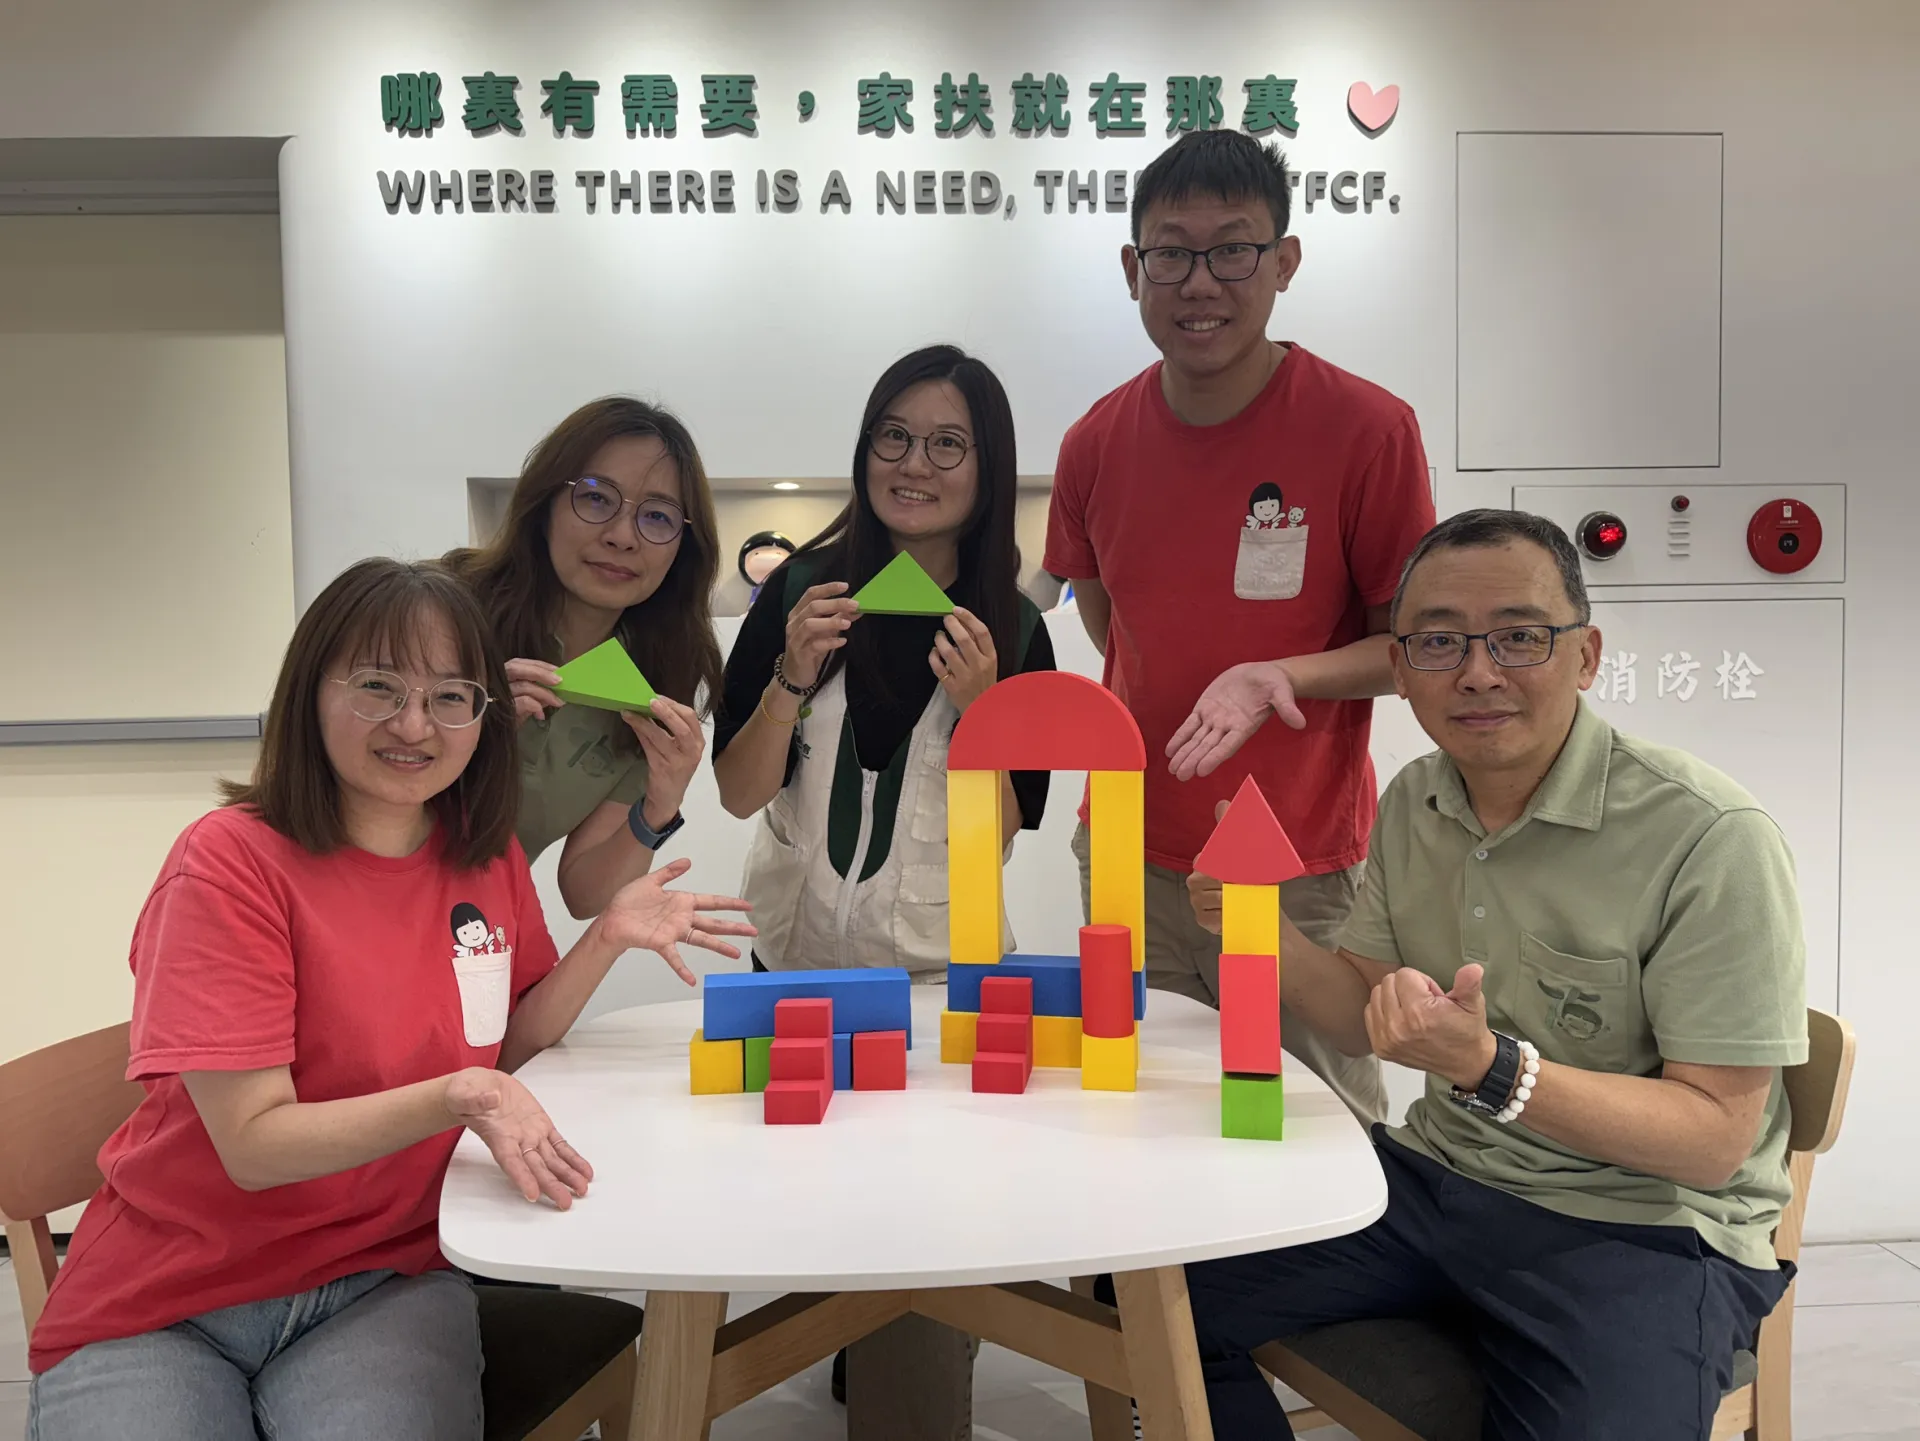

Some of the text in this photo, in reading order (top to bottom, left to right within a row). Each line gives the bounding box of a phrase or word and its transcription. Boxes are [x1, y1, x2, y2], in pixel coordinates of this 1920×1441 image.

[376, 169, 554, 204] WHERE
[576, 170, 734, 205] THERE
[757, 169, 799, 205] IS
[821, 170, 852, 205] A
[876, 170, 1015, 211] NEED,
[1597, 650, 1765, 704] 消防栓
